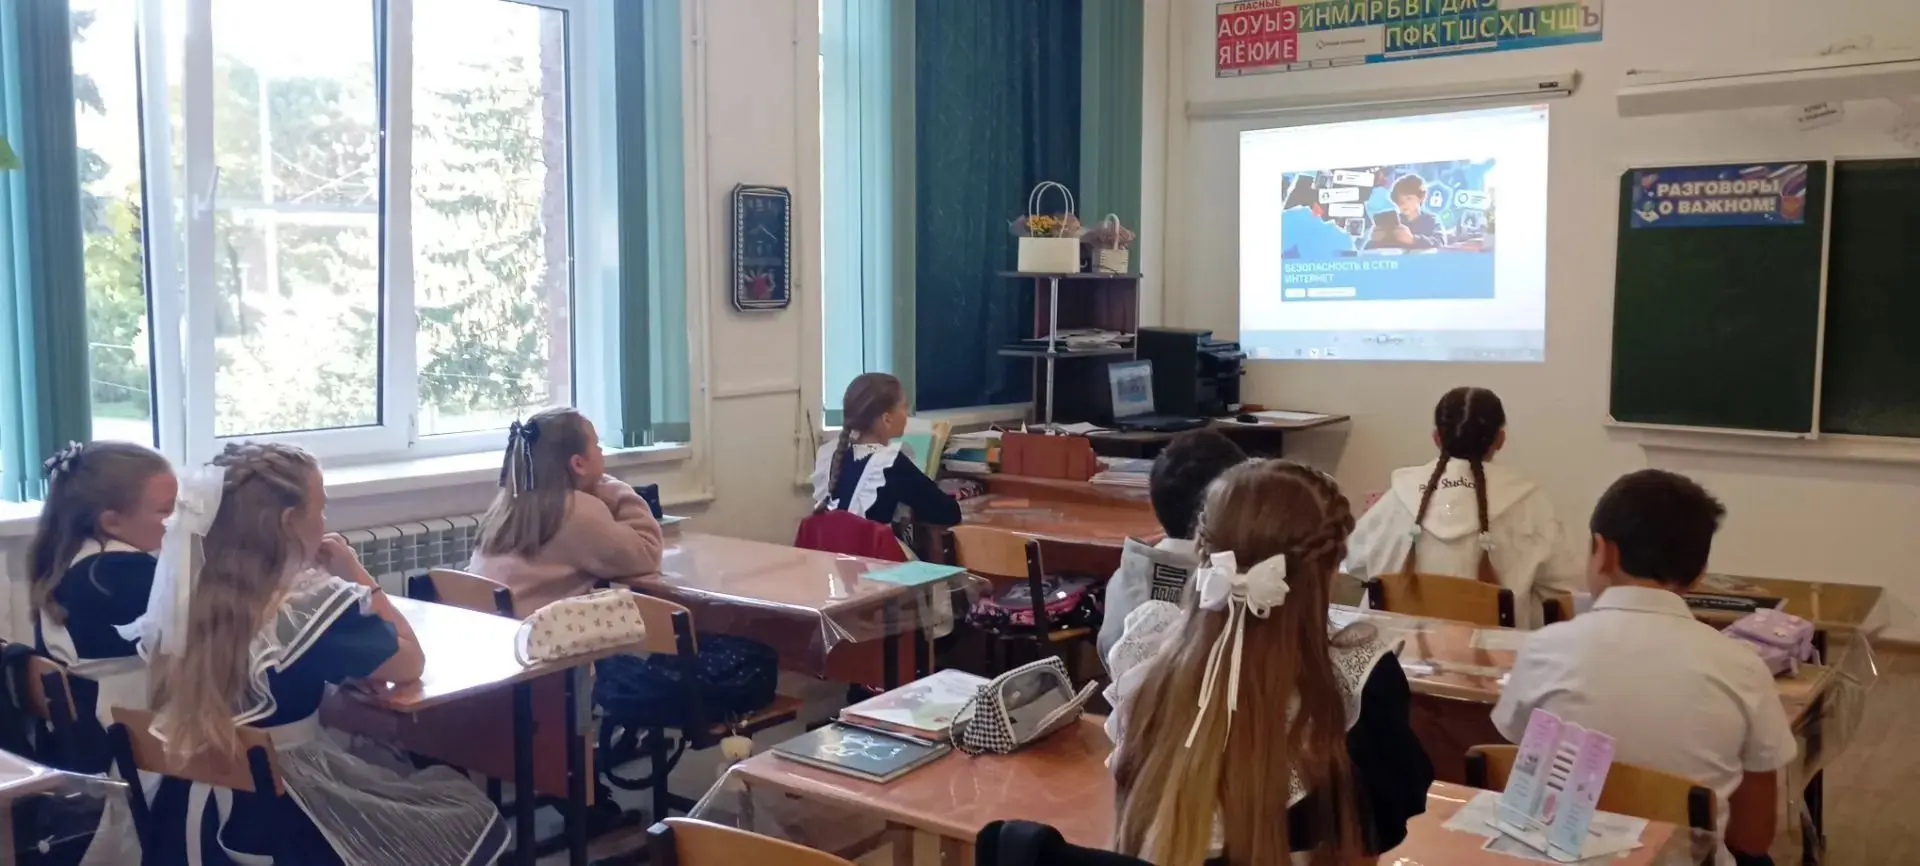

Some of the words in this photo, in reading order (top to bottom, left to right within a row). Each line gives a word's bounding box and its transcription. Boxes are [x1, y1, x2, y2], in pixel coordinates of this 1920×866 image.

[1233, 0, 1281, 11] ГЛАСНЫЕ
[1657, 179, 1779, 197] РАЗГОВОРЫ
[1658, 200, 1674, 215] О
[1678, 197, 1776, 213] ВАЖНОМ!
[1285, 261, 1361, 272] БЕЗОПАСНОСТЬ
[1363, 261, 1371, 271] В
[1372, 260, 1399, 271] СЕТИ
[1285, 273, 1334, 283] ИНТЕРНЕТ
[1441, 476, 1476, 489] Studio
